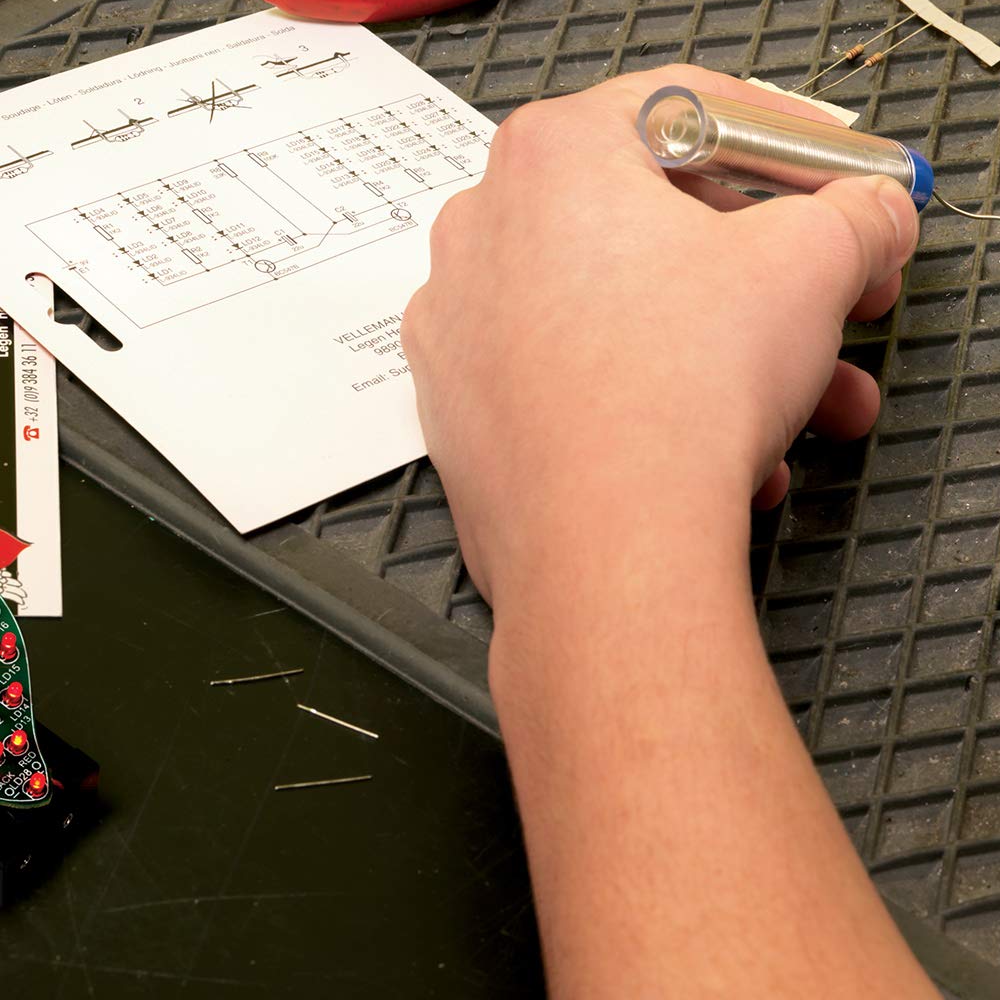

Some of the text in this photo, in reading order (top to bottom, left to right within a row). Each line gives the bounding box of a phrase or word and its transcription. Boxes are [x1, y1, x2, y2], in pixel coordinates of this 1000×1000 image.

[298, 44, 309, 52] 3
[133, 97, 145, 106] 2
[333, 314, 402, 345] VELLEMAN
[349, 335, 386, 352] Legen
[22, 368, 38, 385] 384
[352, 374, 389, 392] Email:
[24, 385, 40, 403] (0)9
[24, 406, 39, 422] +32
[0, 664, 21, 685] LD15
[10, 703, 30, 722] LD14
[18, 751, 37, 768] RED
